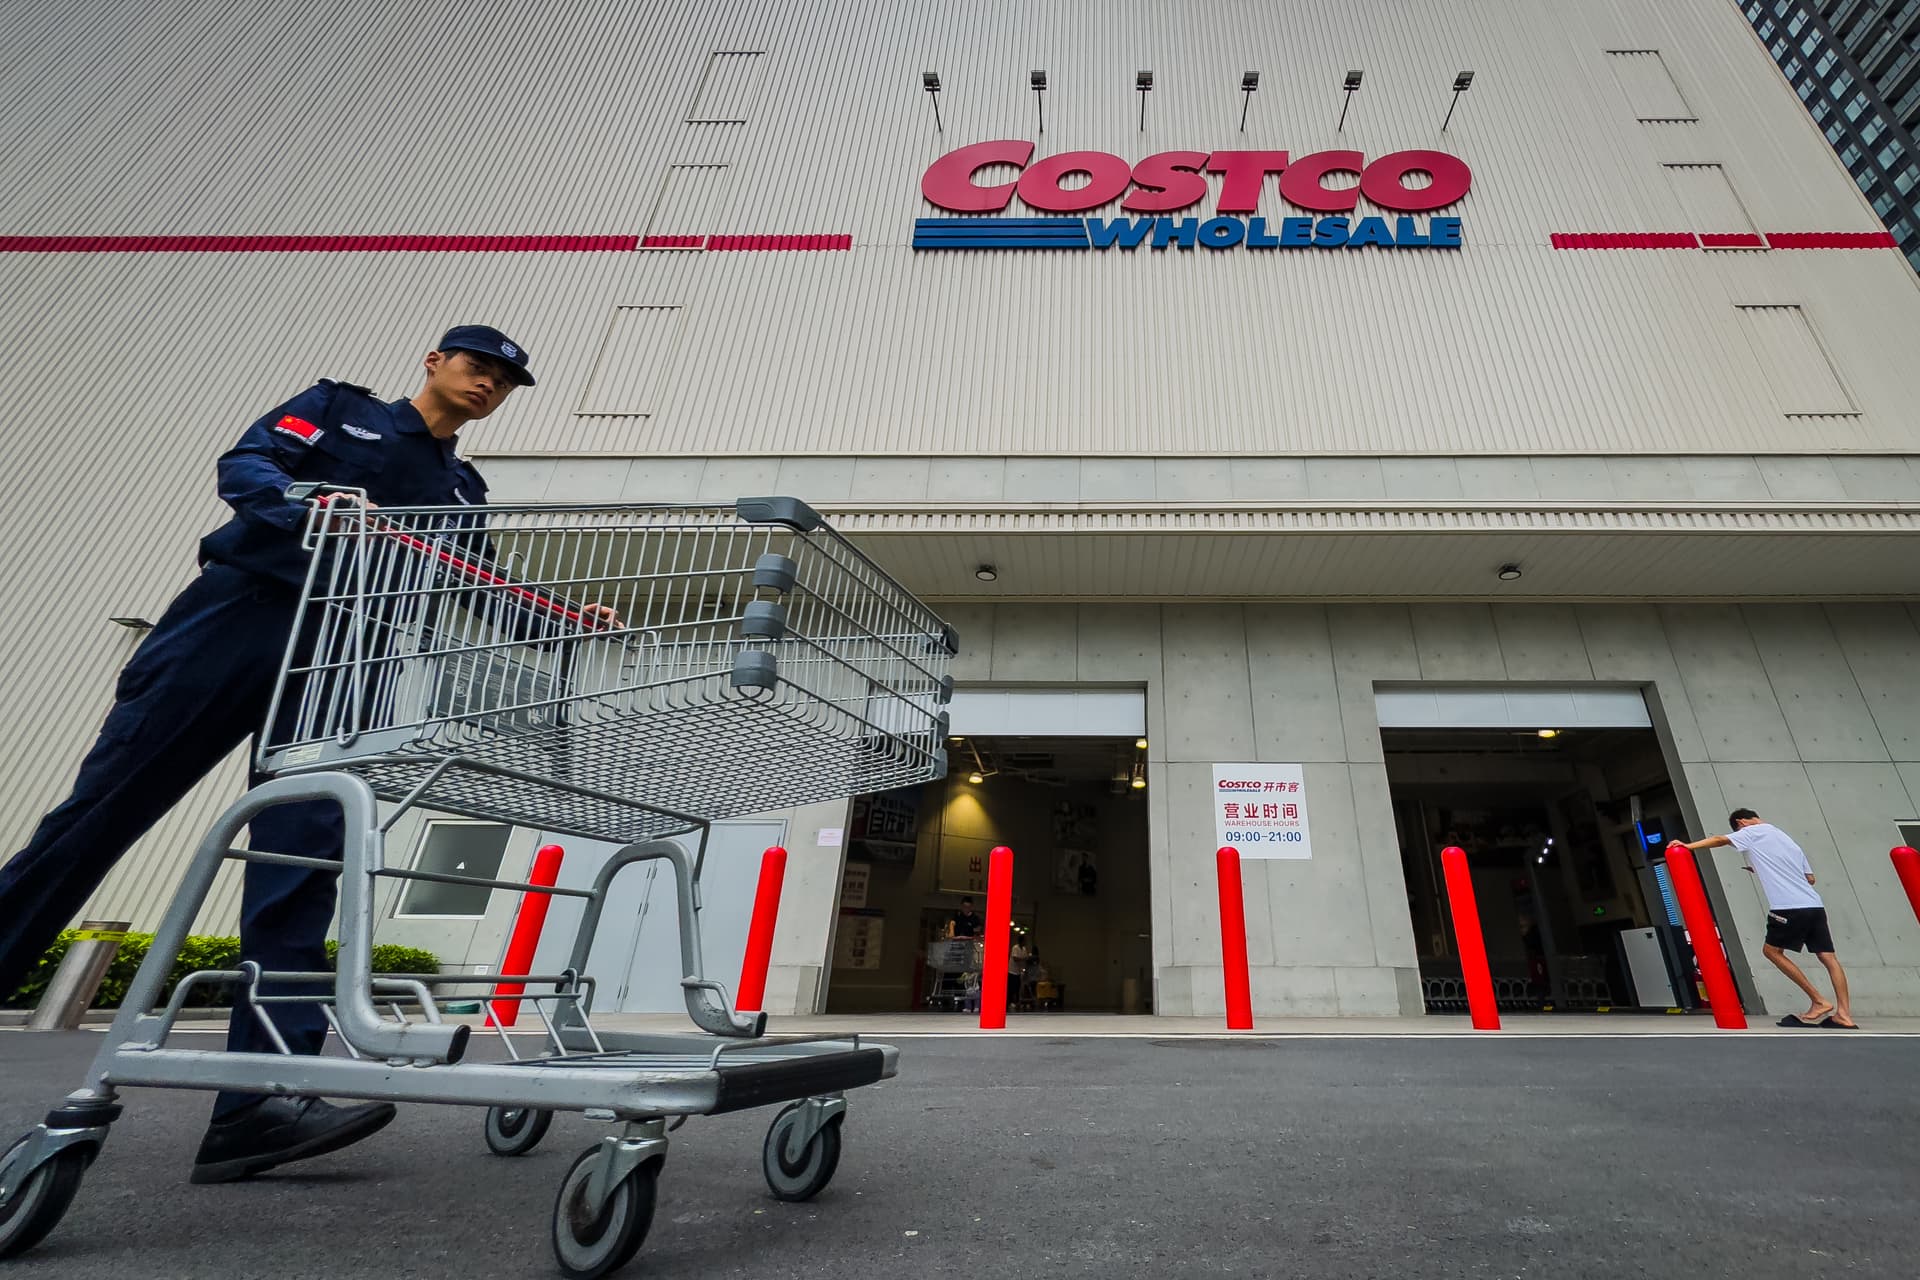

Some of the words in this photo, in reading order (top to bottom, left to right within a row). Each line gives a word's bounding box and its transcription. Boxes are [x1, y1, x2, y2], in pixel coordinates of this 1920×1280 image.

[921, 139, 1473, 214] COSTCO
[1086, 216, 1462, 250] WHOLESALE
[1218, 779, 1261, 788] COSTCO
[1263, 782, 1299, 792] 开市客
[1223, 803, 1298, 819] 营业时间
